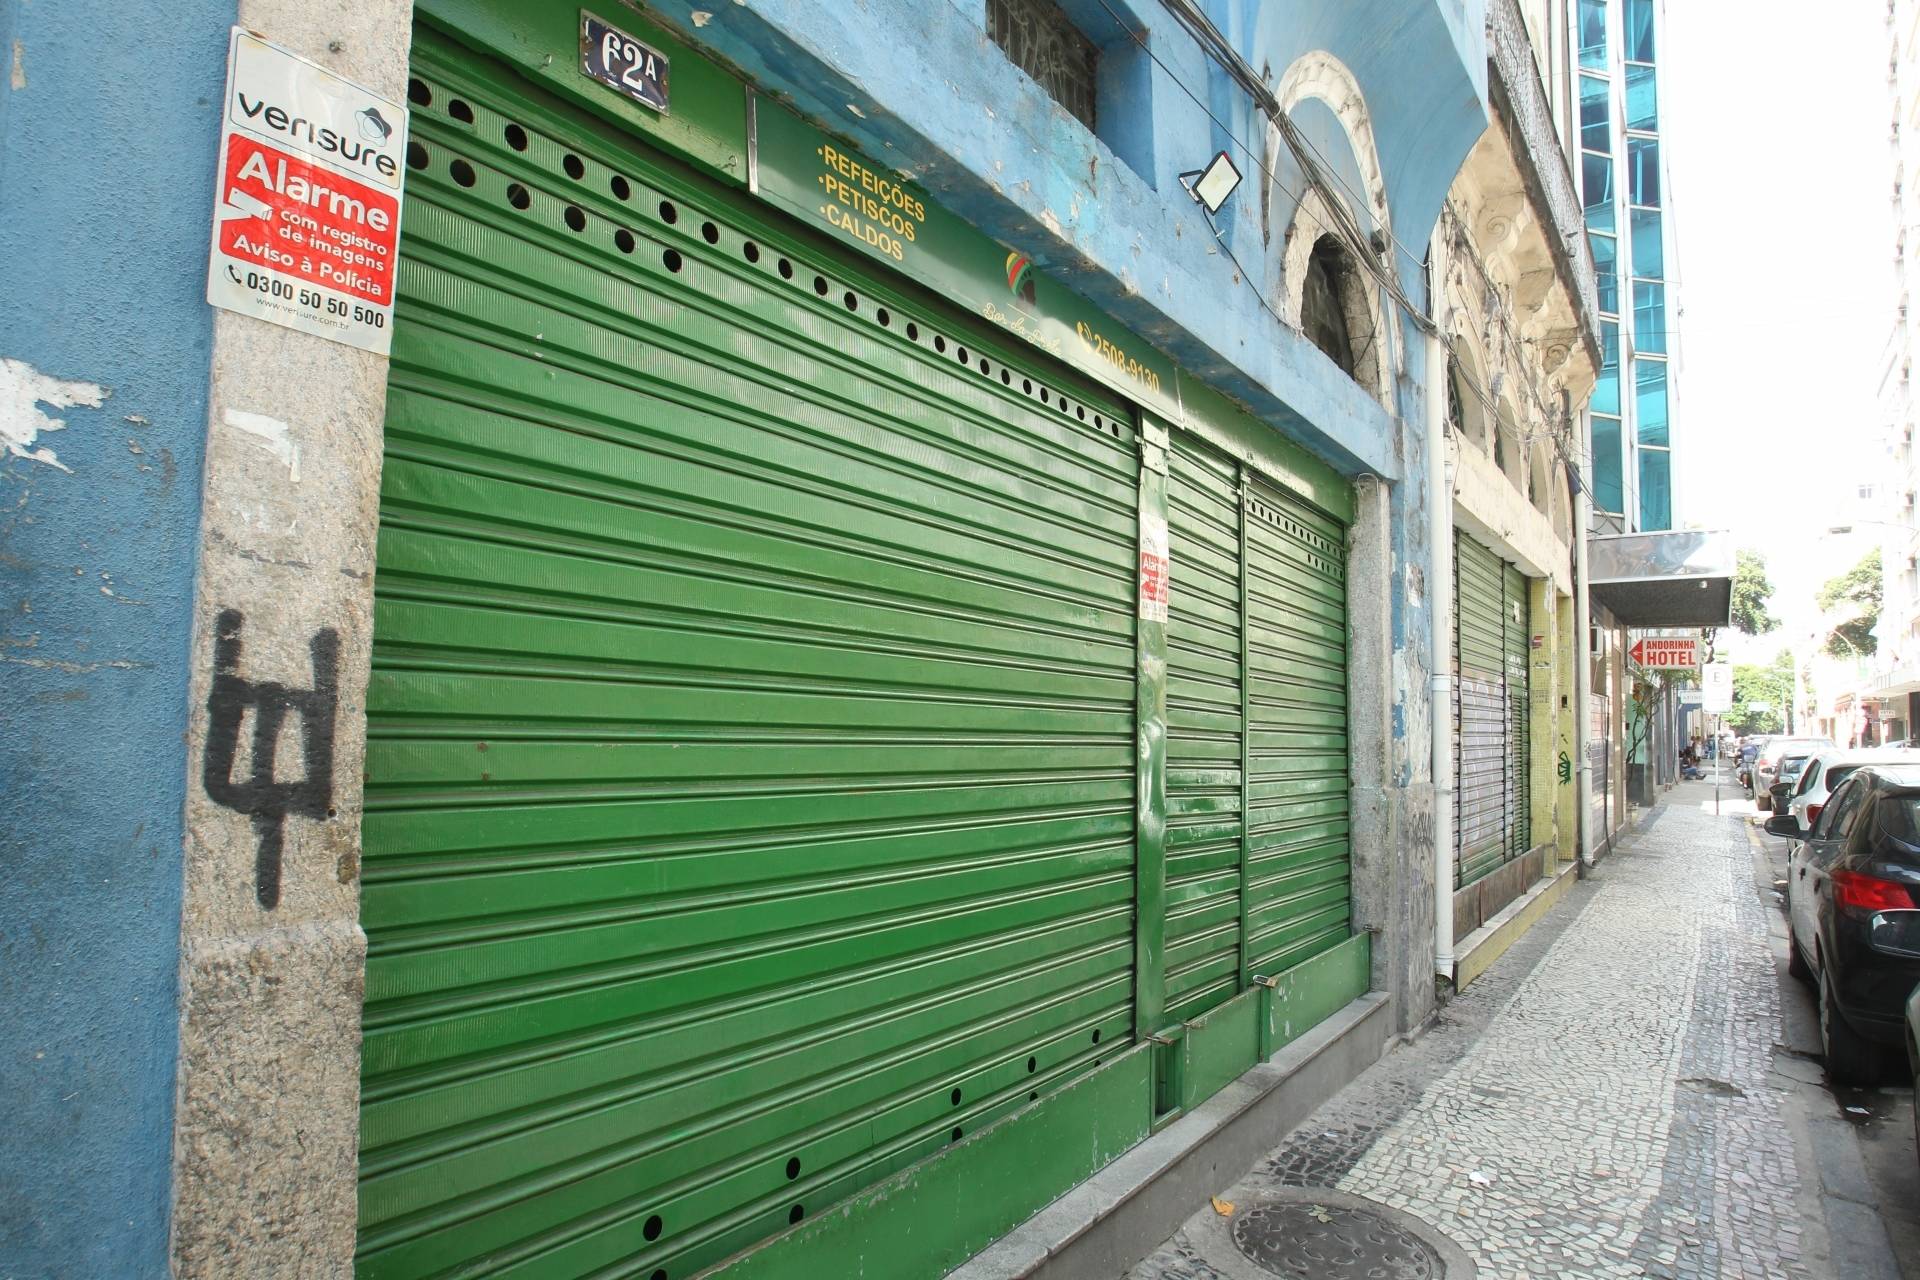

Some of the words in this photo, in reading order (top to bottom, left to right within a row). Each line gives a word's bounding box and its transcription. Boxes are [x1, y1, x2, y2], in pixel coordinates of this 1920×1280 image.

[238, 92, 396, 177] verisure
[236, 150, 390, 233] Alarme
[824, 144, 925, 222] REFEIÇÕES
[825, 173, 915, 242] PETISCOS
[279, 224, 303, 244] de
[309, 236, 385, 272] imagens
[280, 208, 318, 232] com
[322, 220, 388, 256] registro
[826, 204, 903, 261] CALDOS
[233, 233, 294, 267] Aviso
[301, 252, 312, 274] à
[319, 263, 382, 297] Polícia
[247, 271, 294, 300] 0300
[299, 289, 321, 309] 50
[327, 297, 348, 318] 50
[353, 304, 385, 329] 500
[1094, 333, 1160, 395] 2508-9130
[1646, 640, 1695, 650] ANDORINHA
[1646, 651, 1696, 666] HOTEL
